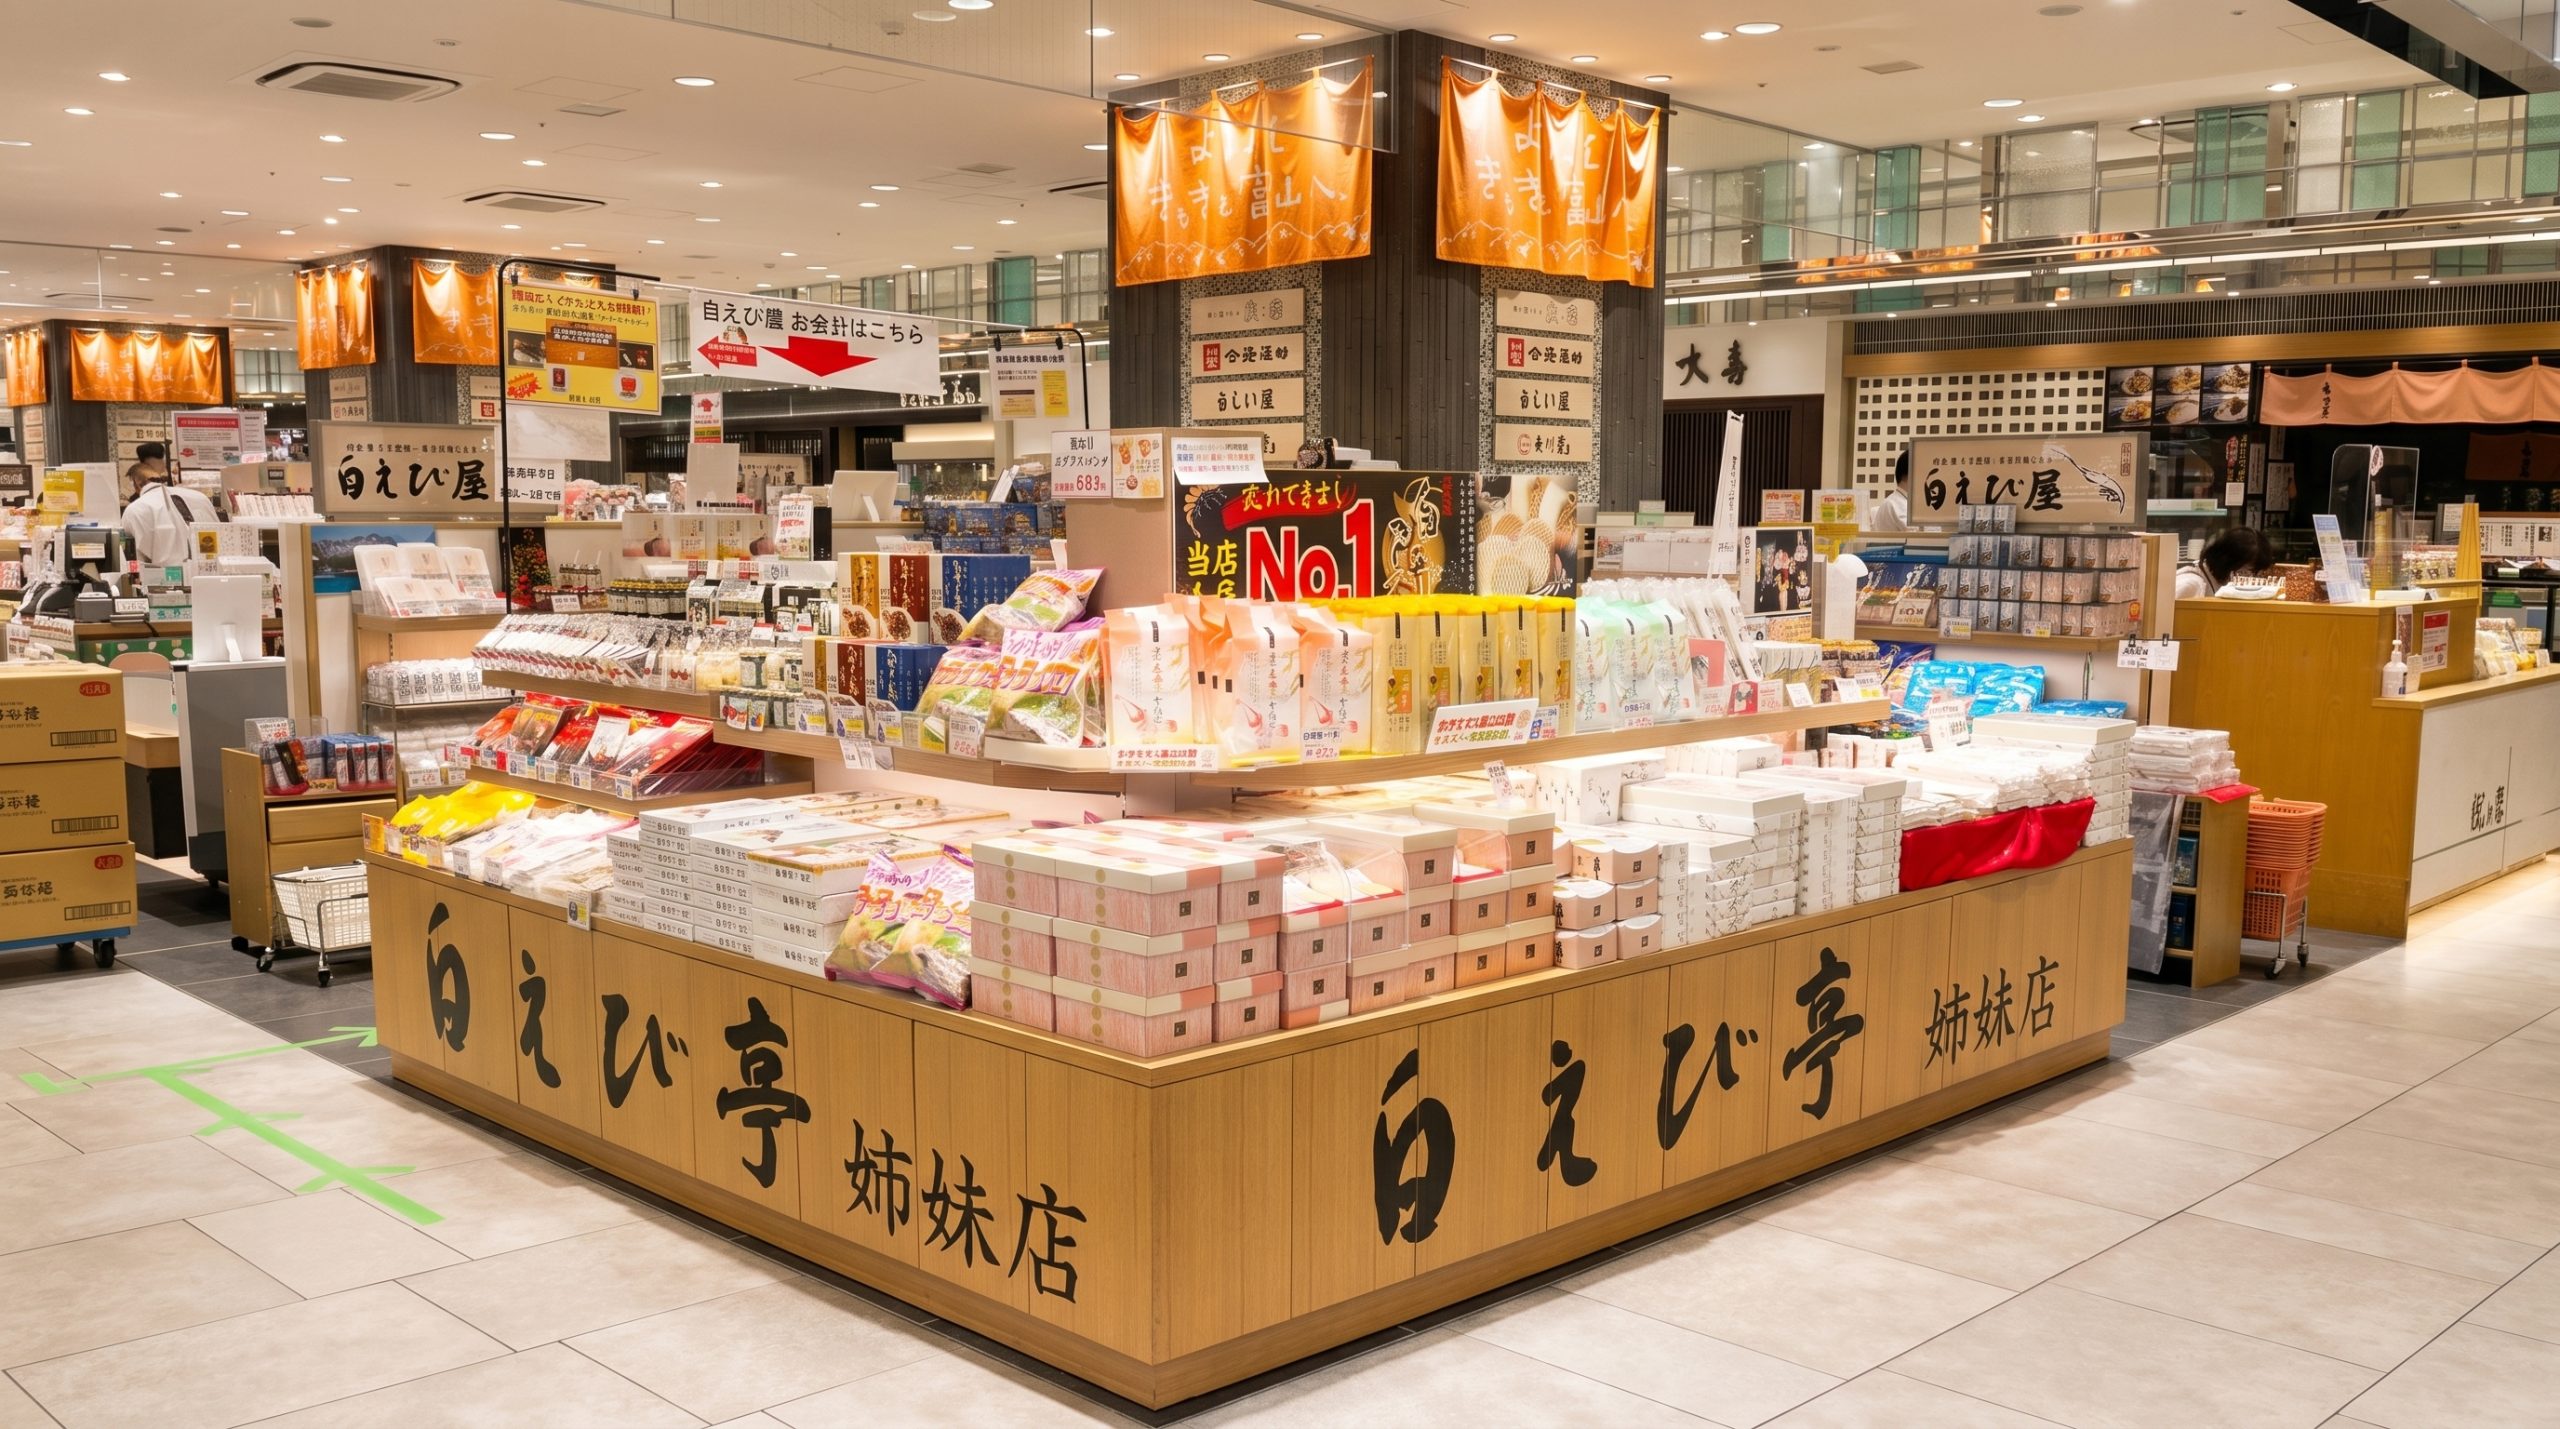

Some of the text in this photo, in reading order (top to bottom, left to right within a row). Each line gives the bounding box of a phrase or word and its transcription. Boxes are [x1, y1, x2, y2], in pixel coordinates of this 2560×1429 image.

[338, 454, 489, 500] 白えび屋
[1924, 468, 2063, 511] 白えび屋
[1187, 539, 1238, 577] 当店
[1246, 498, 1375, 602] No.1
[426, 902, 812, 1190] 白えび亭
[843, 1118, 1088, 1304] 姉妹店
[1373, 947, 2060, 1246] 白えび亭 姉妹店
